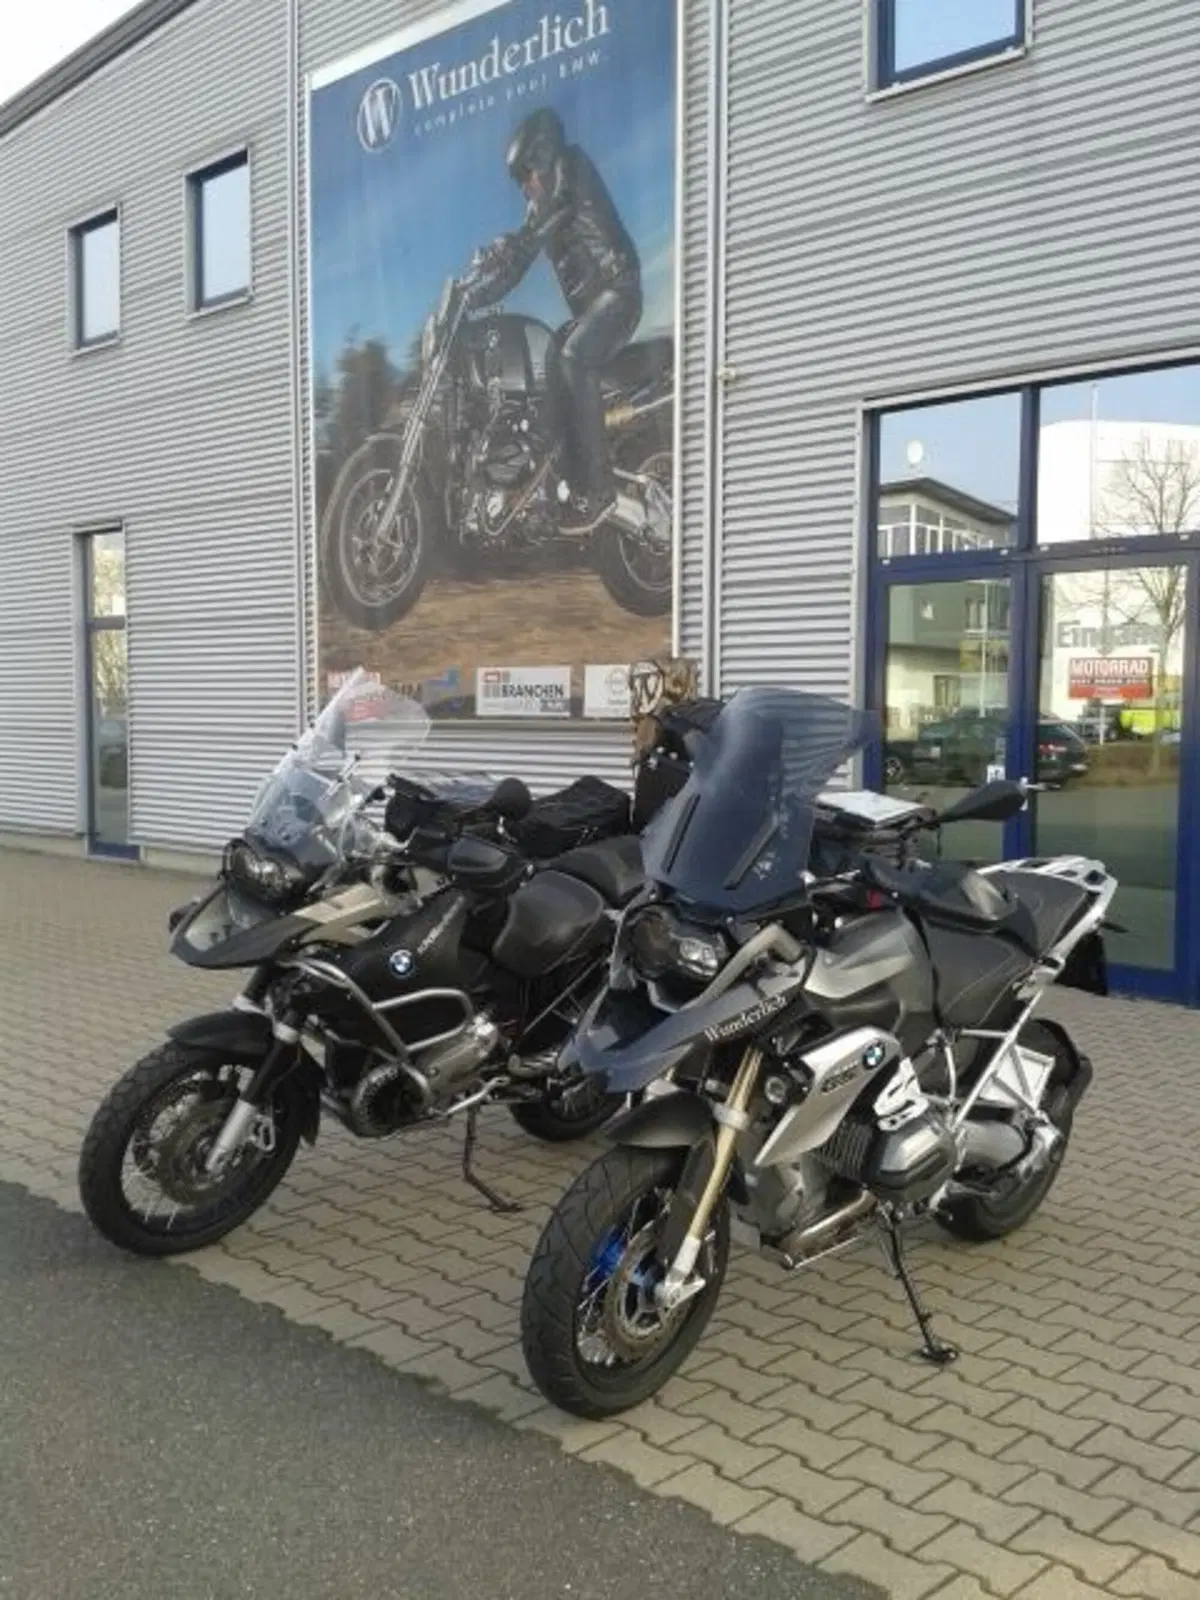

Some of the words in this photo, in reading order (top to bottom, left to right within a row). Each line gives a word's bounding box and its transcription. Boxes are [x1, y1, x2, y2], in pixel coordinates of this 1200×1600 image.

[408, 0, 612, 111] Wunderlich
[1070, 659, 1149, 676] MOTORRAD
[501, 683, 565, 699] BRANCHEN
[704, 993, 788, 1043] Wunderlich
